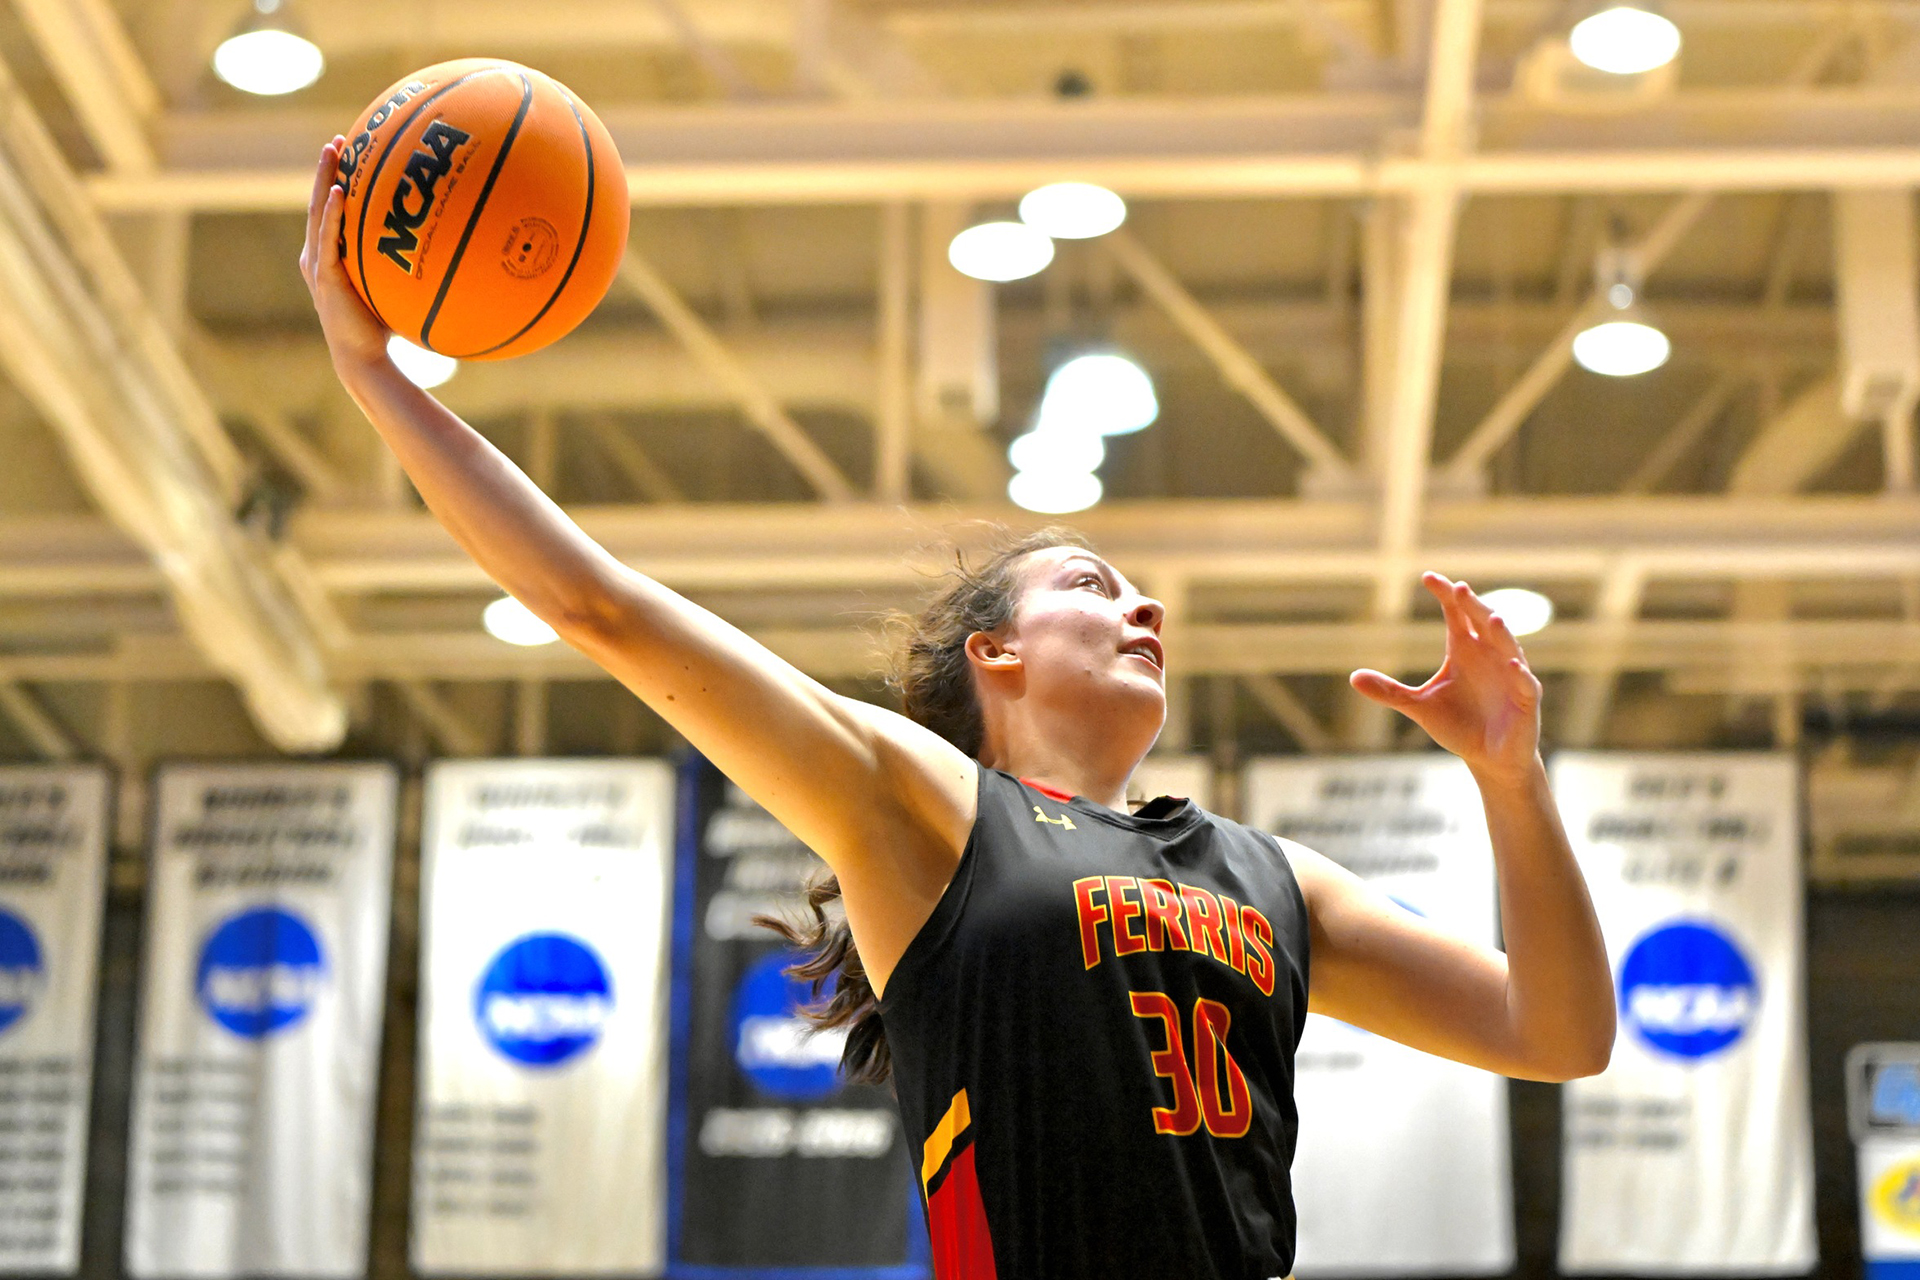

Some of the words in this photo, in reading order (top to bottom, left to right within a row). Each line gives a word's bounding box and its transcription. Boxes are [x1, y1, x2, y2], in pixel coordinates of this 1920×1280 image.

[377, 119, 474, 276] NCAA
[434, 176, 458, 219] GAME
[456, 139, 482, 175] BALL
[1072, 875, 1276, 998] FERRIS
[1128, 990, 1253, 1139] 30
